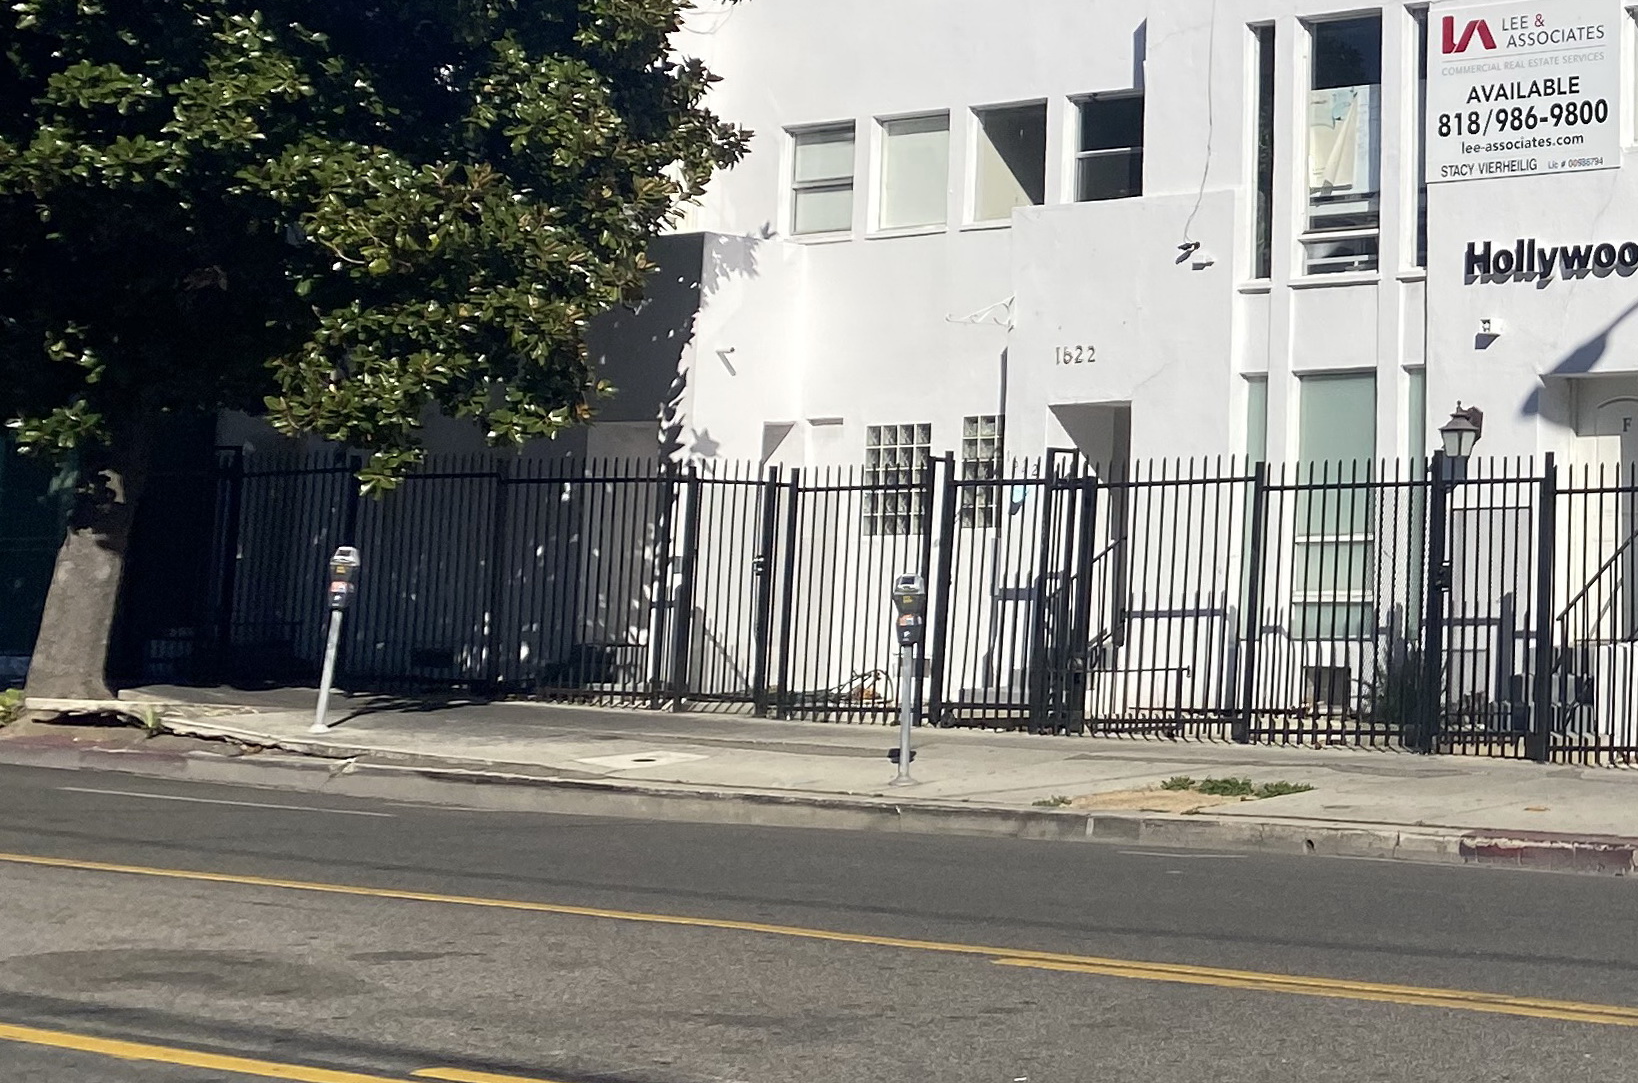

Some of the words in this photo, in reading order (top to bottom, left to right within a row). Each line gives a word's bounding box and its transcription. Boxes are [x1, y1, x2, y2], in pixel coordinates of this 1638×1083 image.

[1502, 16, 1529, 32] LEE
[1534, 13, 1545, 28] &
[1506, 25, 1605, 49] ASSOCIATES
[1442, 63, 1501, 76] COMMERCIAL
[1504, 60, 1525, 70] REAL
[1528, 56, 1559, 68] ESTATE
[1562, 52, 1605, 64] SERVICES
[1466, 76, 1580, 104] AVAILABLE
[1438, 98, 1608, 138] 818/986-9800
[1462, 134, 1584, 154] lee-associates.com
[1441, 163, 1475, 178] STACY
[1478, 158, 1537, 174] VIERHEILIG
[1055, 345, 1096, 365] 1622
[1623, 417, 1632, 432] F
